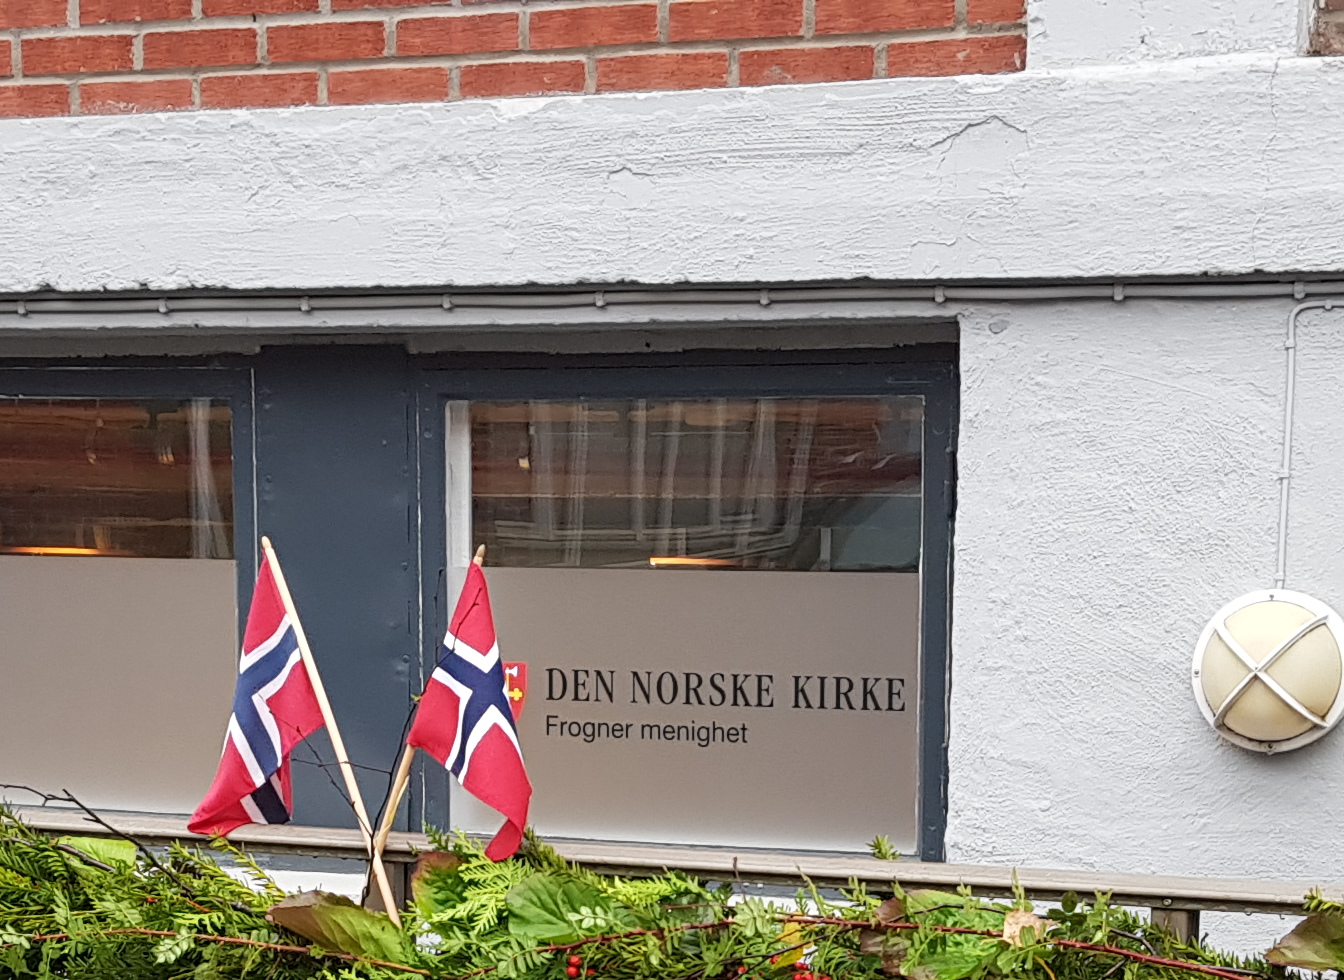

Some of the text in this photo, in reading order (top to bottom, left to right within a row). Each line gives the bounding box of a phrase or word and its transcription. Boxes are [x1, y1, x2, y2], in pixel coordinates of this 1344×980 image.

[545, 668, 907, 712] DEN NORSKE KIRKE
[546, 715, 748, 748] Frogner menighet
